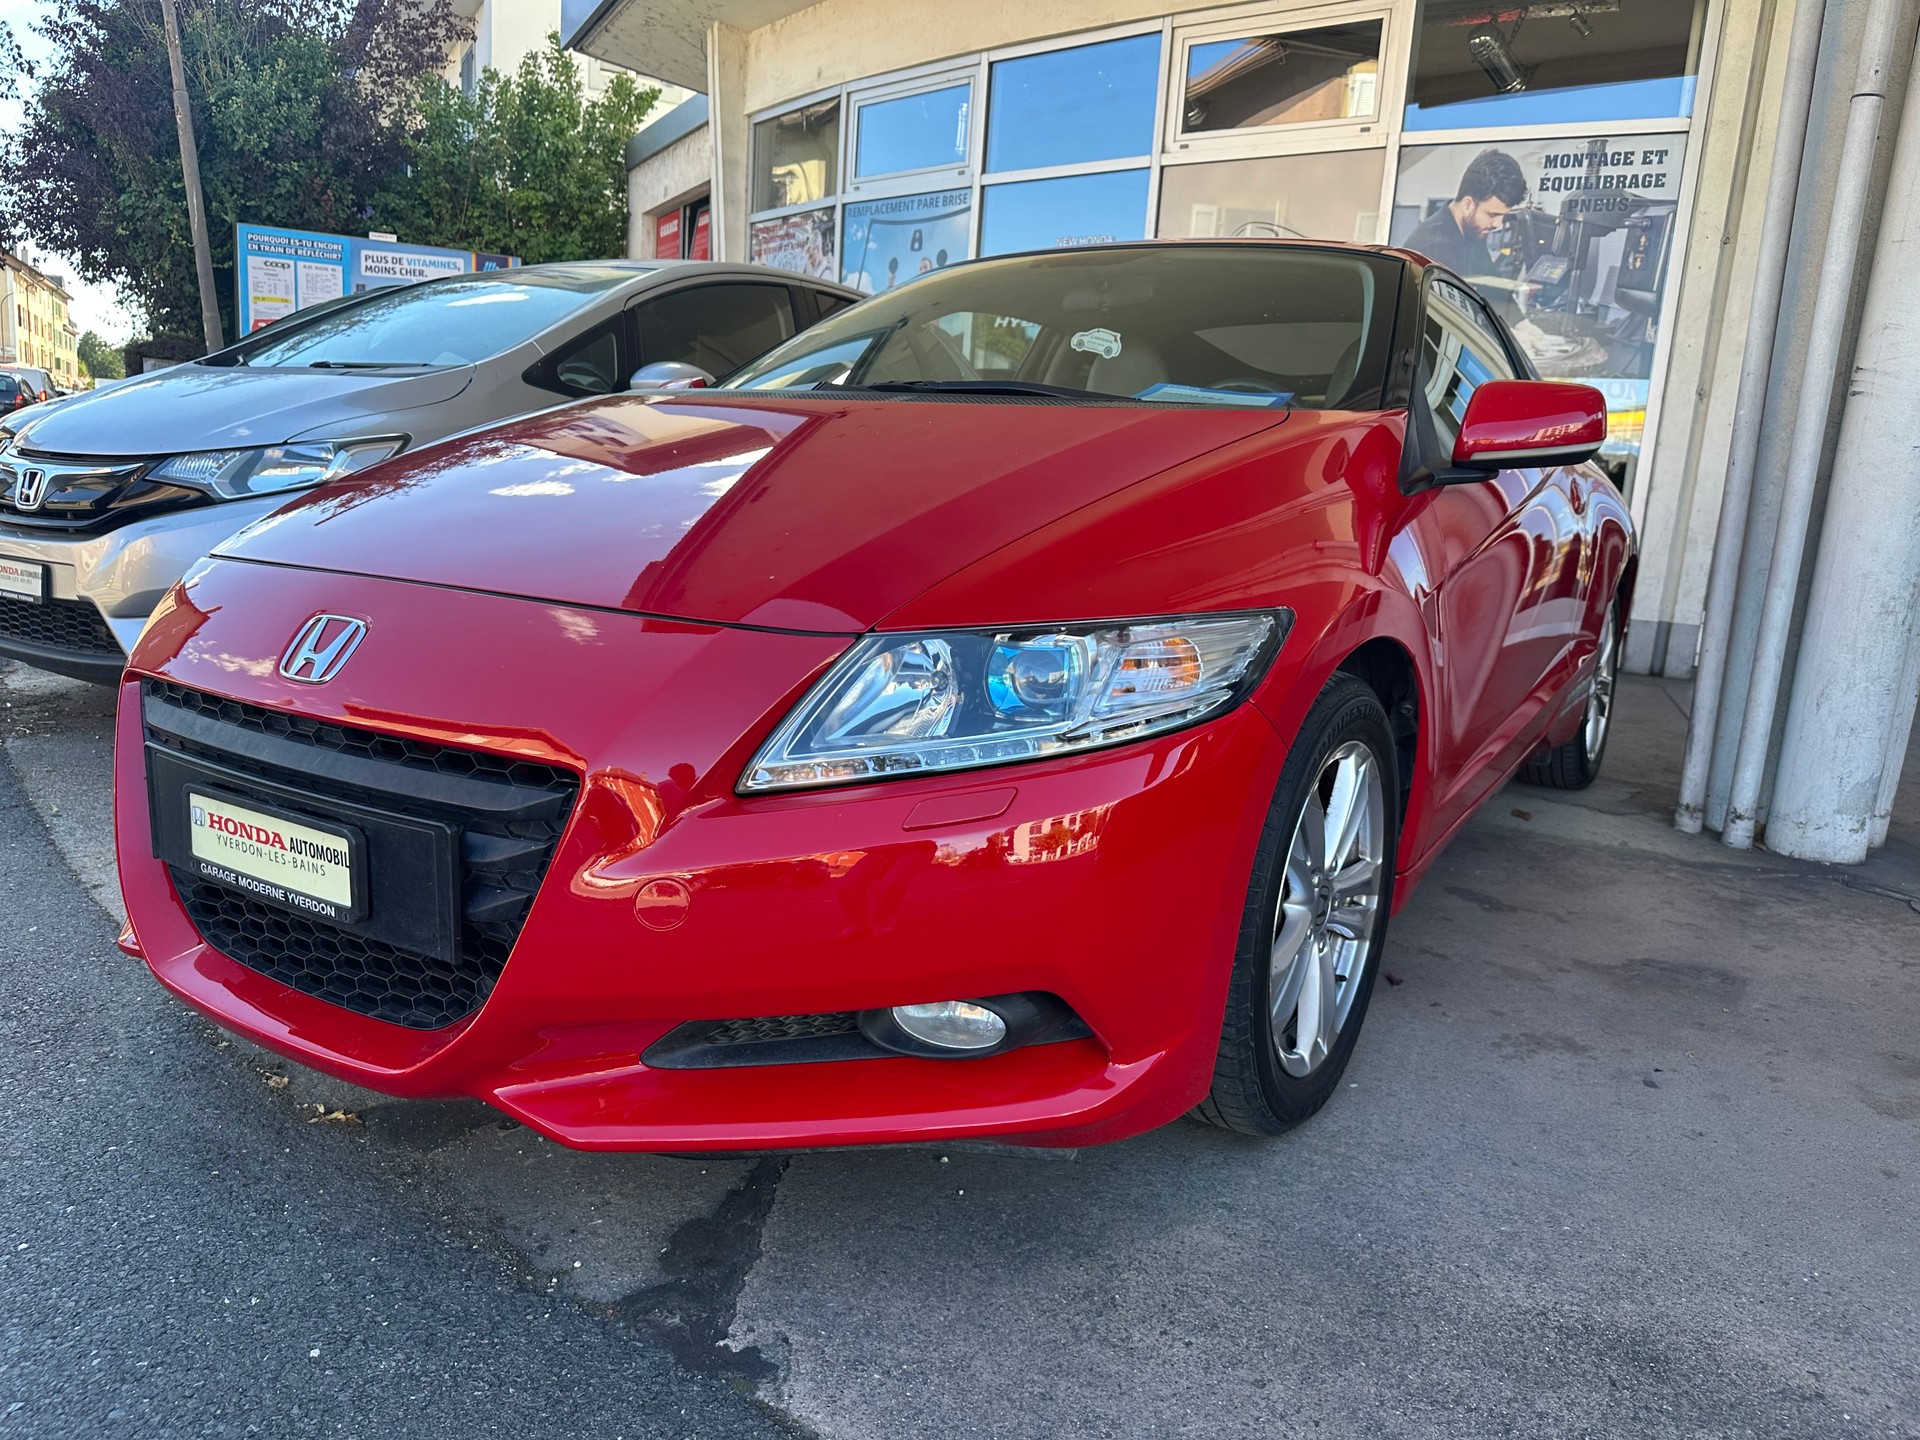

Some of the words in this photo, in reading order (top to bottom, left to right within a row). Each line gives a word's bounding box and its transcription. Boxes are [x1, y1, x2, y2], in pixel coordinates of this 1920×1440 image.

[1543, 151, 1635, 169] MONTAGE
[1641, 149, 1669, 165] ET
[1538, 173, 1667, 193] ÉQUILIBRAGE
[847, 200, 916, 218] REMPLACEMENT
[917, 196, 940, 210] PARE
[942, 193, 969, 207] BRISE
[1567, 198, 1630, 213] PNEUS
[247, 233, 289, 245] POURQUOI
[290, 238, 312, 248] ES-TU
[313, 241, 343, 252] ENCORE
[247, 243, 259, 251] EN
[260, 244, 284, 254] TRAIN
[285, 247, 296, 255] DE
[297, 248, 342, 261] RÉFLÉCHIR?
[264, 260, 290, 270] coop
[364, 254, 389, 265] PLUS
[391, 256, 404, 266] DE
[406, 258, 461, 271] VITAMINES,
[364, 265, 397, 275] MOINS
[399, 267, 428, 278] CHER.
[208, 812, 288, 851] HONDA
[289, 837, 350, 869] AUTOMOBIL
[216, 834, 326, 876] YVERDON-LES-BAINS
[200, 863, 237, 884] GARAGE
[238, 876, 285, 901] MODERNE
[286, 892, 336, 918] YVERDON
